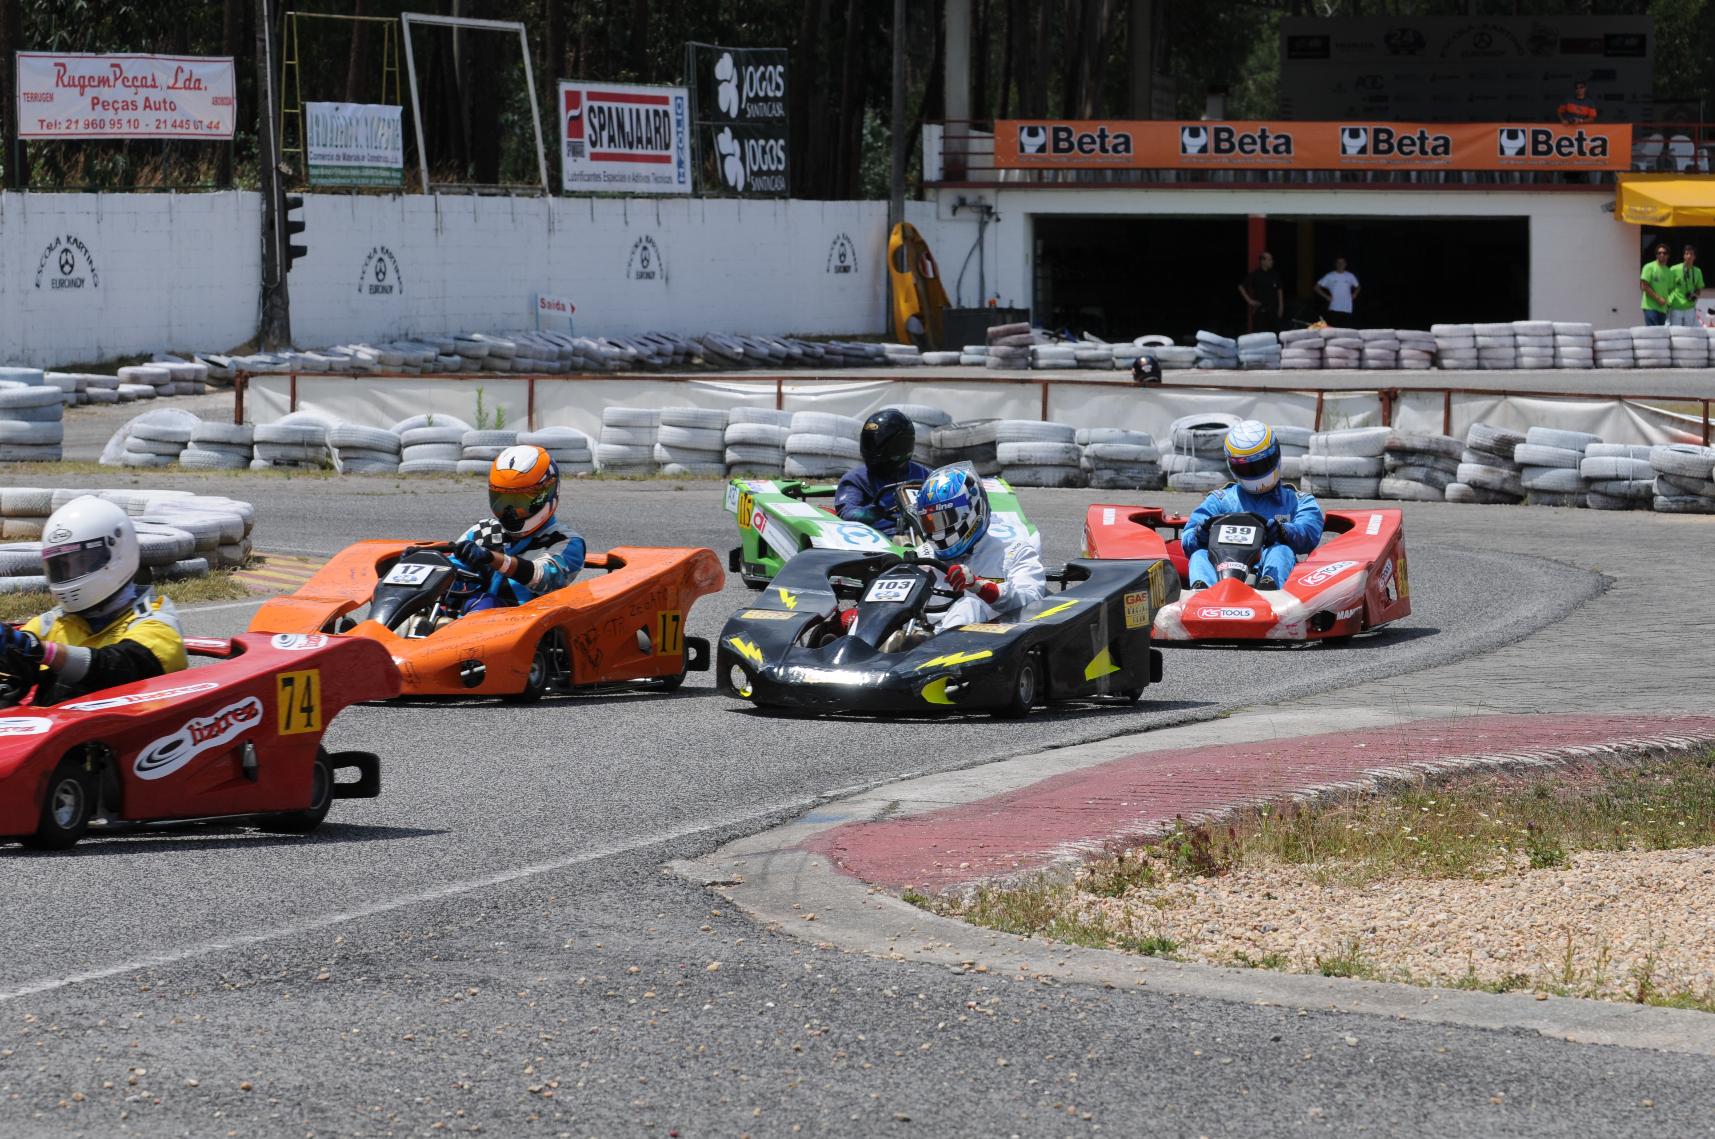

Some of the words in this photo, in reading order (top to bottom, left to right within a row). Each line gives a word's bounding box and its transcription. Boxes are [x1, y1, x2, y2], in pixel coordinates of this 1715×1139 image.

[167, 65, 207, 91] Lda.
[741, 65, 785, 110] JOGOS
[91, 96, 138, 114] Peças
[143, 96, 177, 112] Auto
[38, 119, 61, 130] Tel:
[65, 119, 80, 129] 21
[83, 119, 105, 129] 960
[109, 119, 123, 129] 95
[126, 119, 139, 129] 10
[155, 119, 167, 129] 21
[171, 119, 190, 130] 445
[207, 121, 221, 130] 44
[588, 105, 671, 151] SPANJAARD
[1051, 126, 1132, 155] Beta
[1213, 127, 1294, 156] Beta
[1371, 128, 1452, 157] Beta
[1531, 128, 1609, 157] Beta
[745, 139, 786, 182] JOGOS
[1225, 526, 1252, 536] 39
[401, 565, 426, 575] 17
[1304, 572, 1323, 585] KS
[877, 581, 912, 590] 103
[1126, 592, 1147, 604] GAS
[1201, 609, 1220, 617] KS
[1220, 609, 1250, 617] TOOLS
[660, 613, 680, 653] 17
[281, 676, 314, 731] 74
